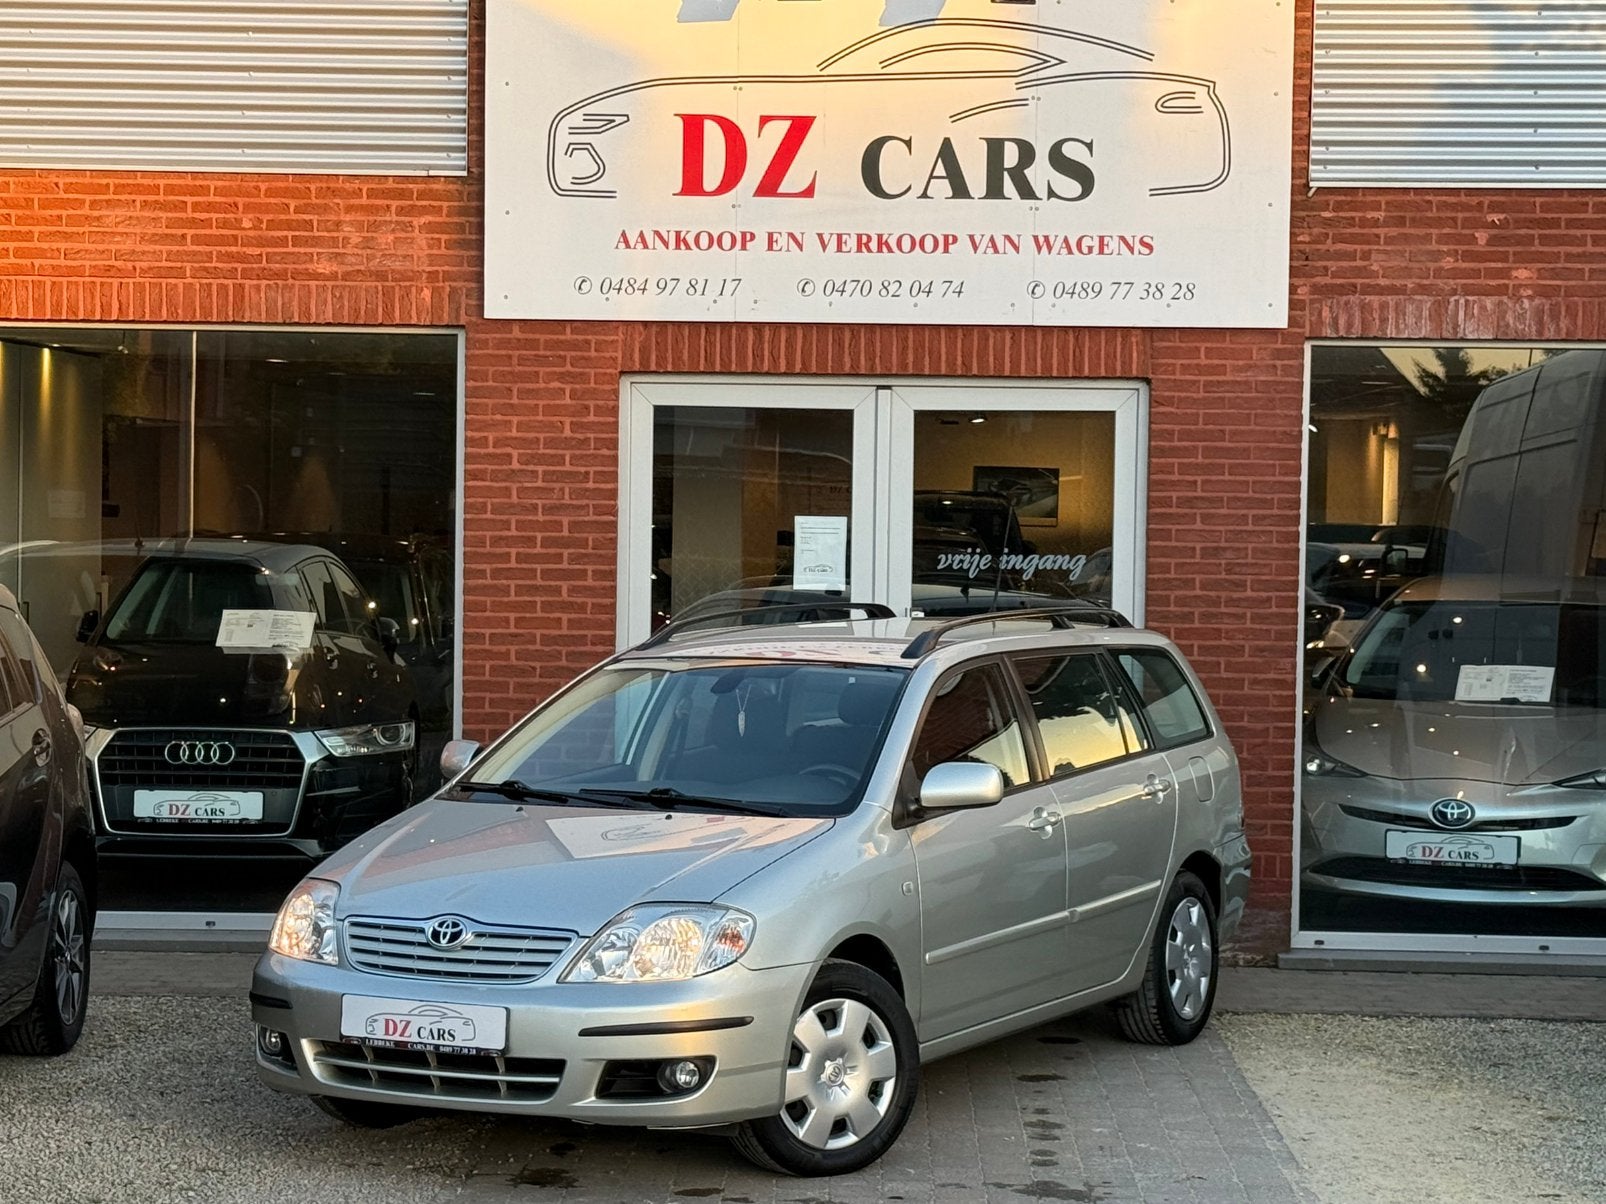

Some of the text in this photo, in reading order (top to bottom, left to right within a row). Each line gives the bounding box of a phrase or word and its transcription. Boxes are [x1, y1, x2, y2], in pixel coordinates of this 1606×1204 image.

[672, 113, 1095, 202] DZ CARS
[615, 229, 1155, 256] AANKOOP EN VERKOOP VAN WAGENS
[600, 277, 742, 298] 0484 97 81 17
[823, 279, 966, 299] 0470 82 04 74
[1053, 281, 1197, 301] 0489 77 38 28
[936, 547, 1087, 581] vrije ingang
[168, 803, 225, 817] DZ CARS
[1421, 845, 1479, 860] DZ CARS
[383, 1018, 456, 1042] DZ CARS
